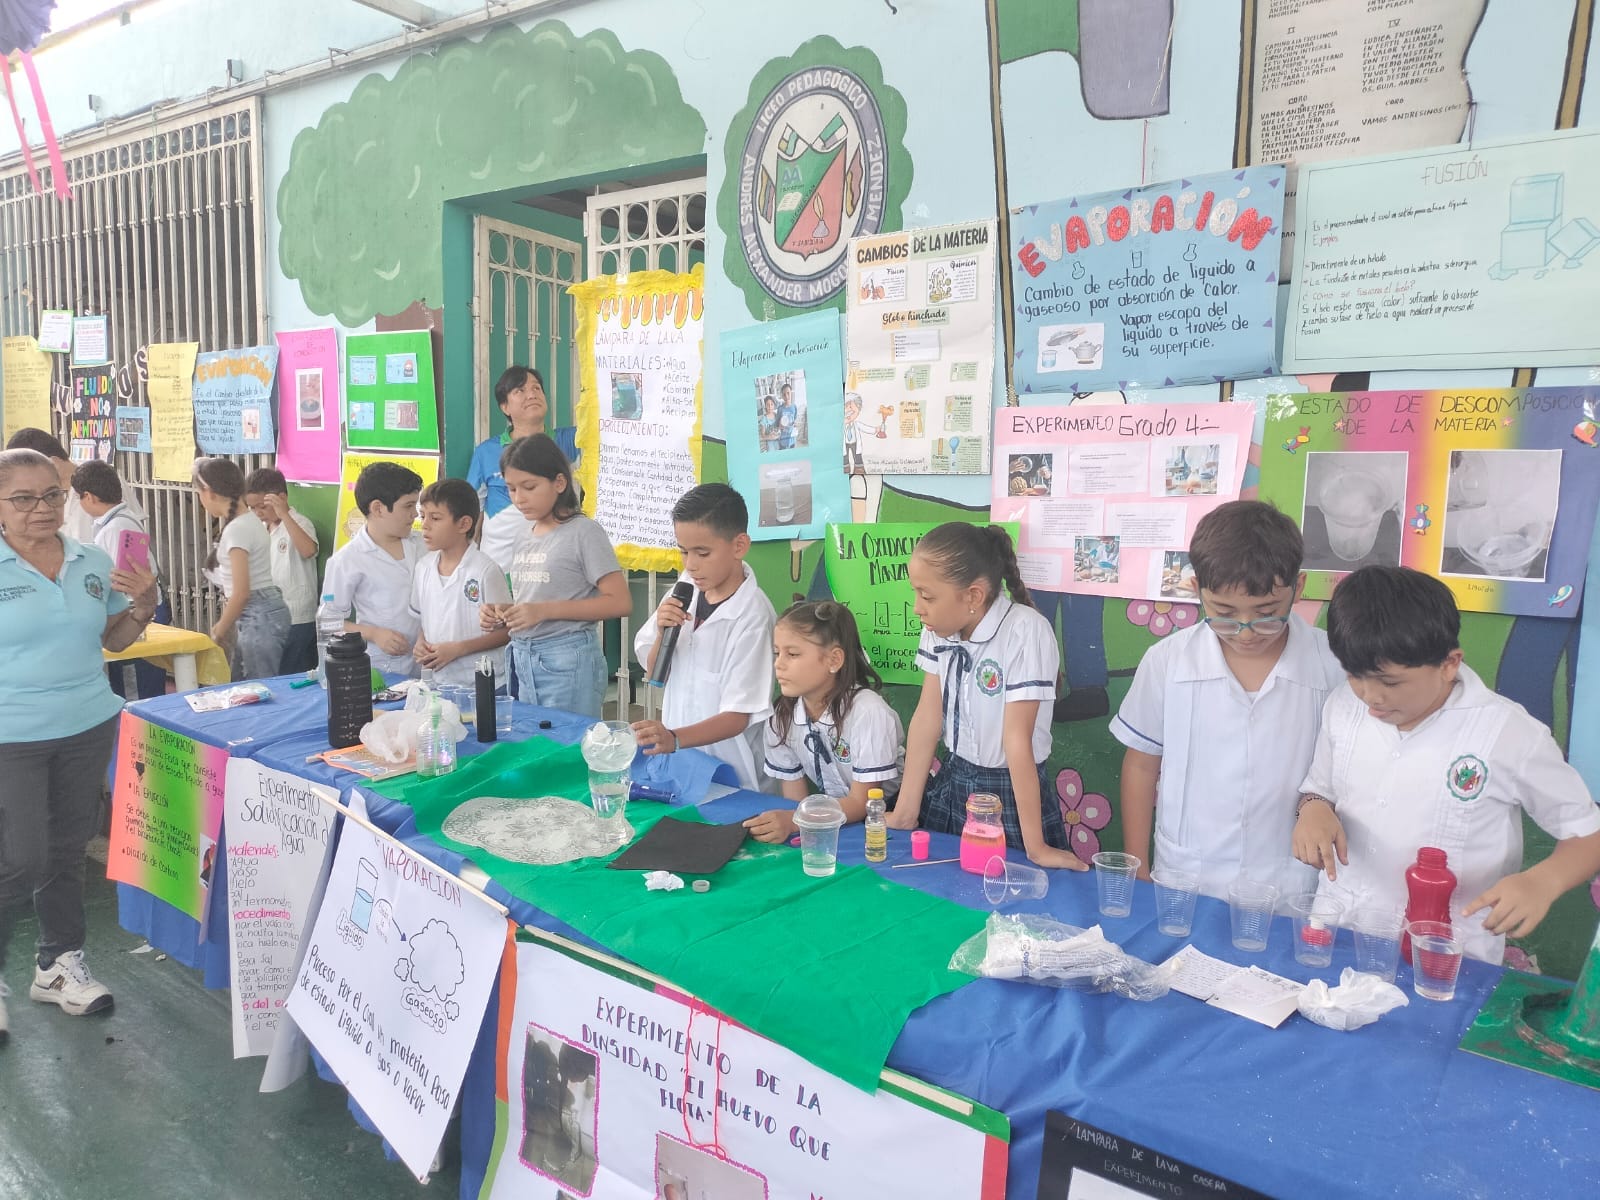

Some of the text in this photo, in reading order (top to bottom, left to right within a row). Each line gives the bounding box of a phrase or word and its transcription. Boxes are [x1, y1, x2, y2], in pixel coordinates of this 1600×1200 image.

[756, 93, 785, 134] LICEO
[1361, 115, 1388, 126] VAMOS
[740, 156, 755, 225] ANDRES
[857, 226, 989, 264] CAMBIOS DE LA MATERIA
[1018, 186, 1273, 278] EVAPORACIÓN
[744, 231, 802, 302] ALEXANDER
[1024, 283, 1074, 303] Cambio
[1084, 275, 1101, 296] de
[1108, 268, 1156, 291] estado
[1163, 267, 1180, 284] de
[1246, 259, 1256, 272] a
[907, 308, 947, 322] hinchado
[1024, 300, 1081, 322] gaseoso
[1090, 296, 1110, 316] por
[1118, 287, 1175, 307] absorción
[1180, 283, 1195, 299] de
[1120, 301, 1229, 326] Vapor escapa del
[1169, 325, 1179, 337] a
[1185, 316, 1227, 334] través
[1232, 315, 1249, 331] de
[76, 375, 113, 397] FLUIDO
[90, 397, 104, 417] NO
[1012, 415, 1113, 433] EXPERIMENTO
[1118, 409, 1176, 436] Grado
[1299, 395, 1371, 415] ESTADO
[1395, 395, 1423, 414] DE
[1344, 416, 1497, 435] DE LA MATERIA
[871, 645, 916, 660] el proce
[893, 660, 906, 670] de
[300, 969, 310, 991] de
[311, 984, 336, 1015] estado
[365, 1040, 373, 1056] a
[378, 1052, 391, 1076] gas
[308, 944, 336, 983] Proceso
[353, 991, 362, 1012] el
[390, 1037, 429, 1087] material
[405, 992, 444, 1029] Gaseoso
[596, 996, 822, 1116] EXPERIMENTO DE LA
[716, 1088, 777, 1135] HUEVO
[789, 1125, 831, 1161] QUE
[1075, 1125, 1227, 1193] LAMPARA DE LAVA CASERA
[1104, 1159, 1183, 1196] EXPERIMENTO
